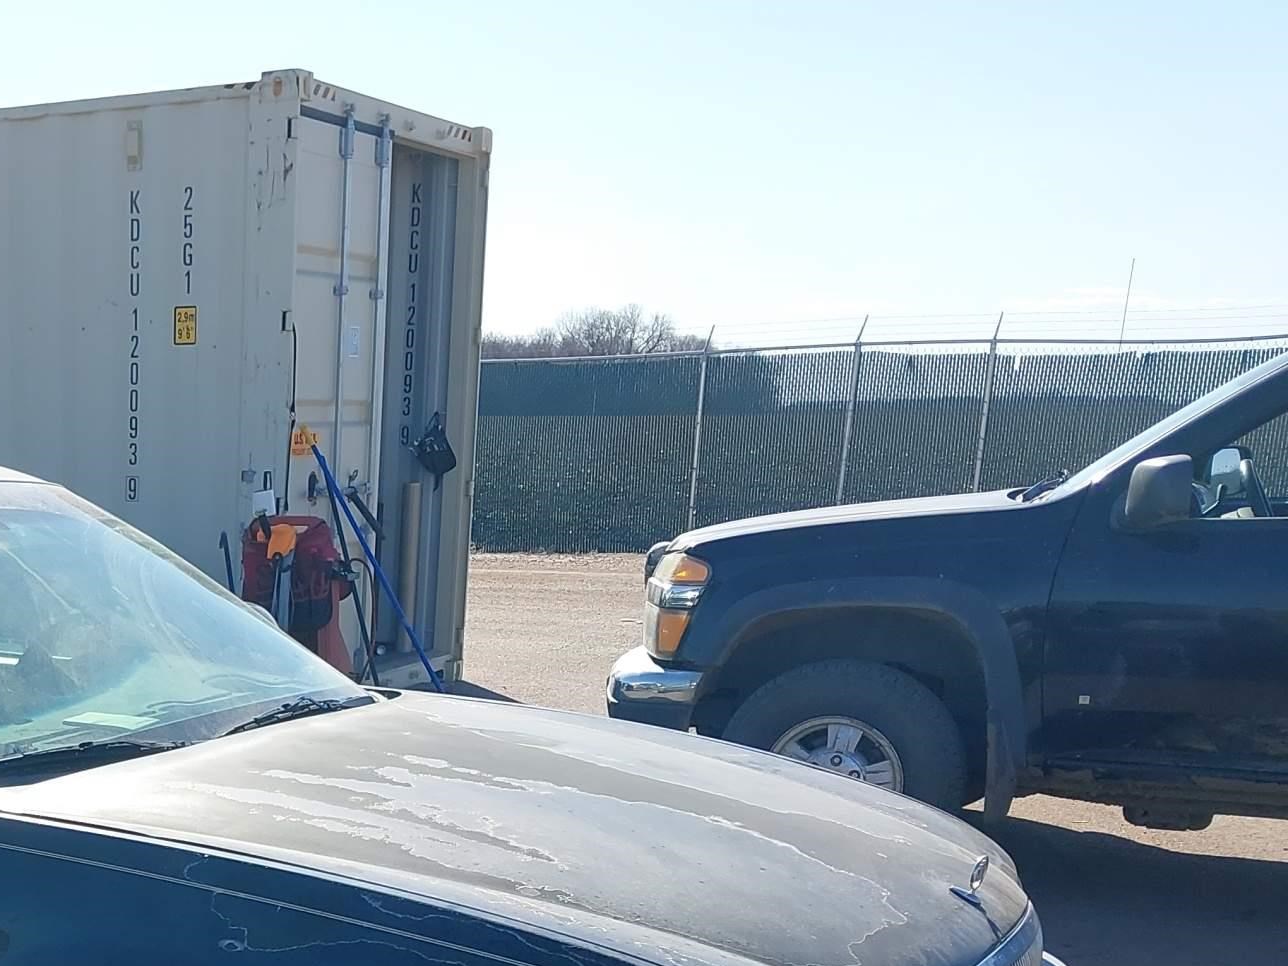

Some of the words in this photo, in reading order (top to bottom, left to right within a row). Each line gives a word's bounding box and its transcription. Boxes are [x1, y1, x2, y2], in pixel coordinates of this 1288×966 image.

[130, 189, 141, 297] KDCU
[183, 186, 193, 295] 25G1
[408, 183, 422, 274] KDCU
[128, 307, 140, 466] 120093
[402, 283, 416, 417] 120093
[128, 477, 137, 500] 9
[400, 425, 410, 446] 9
